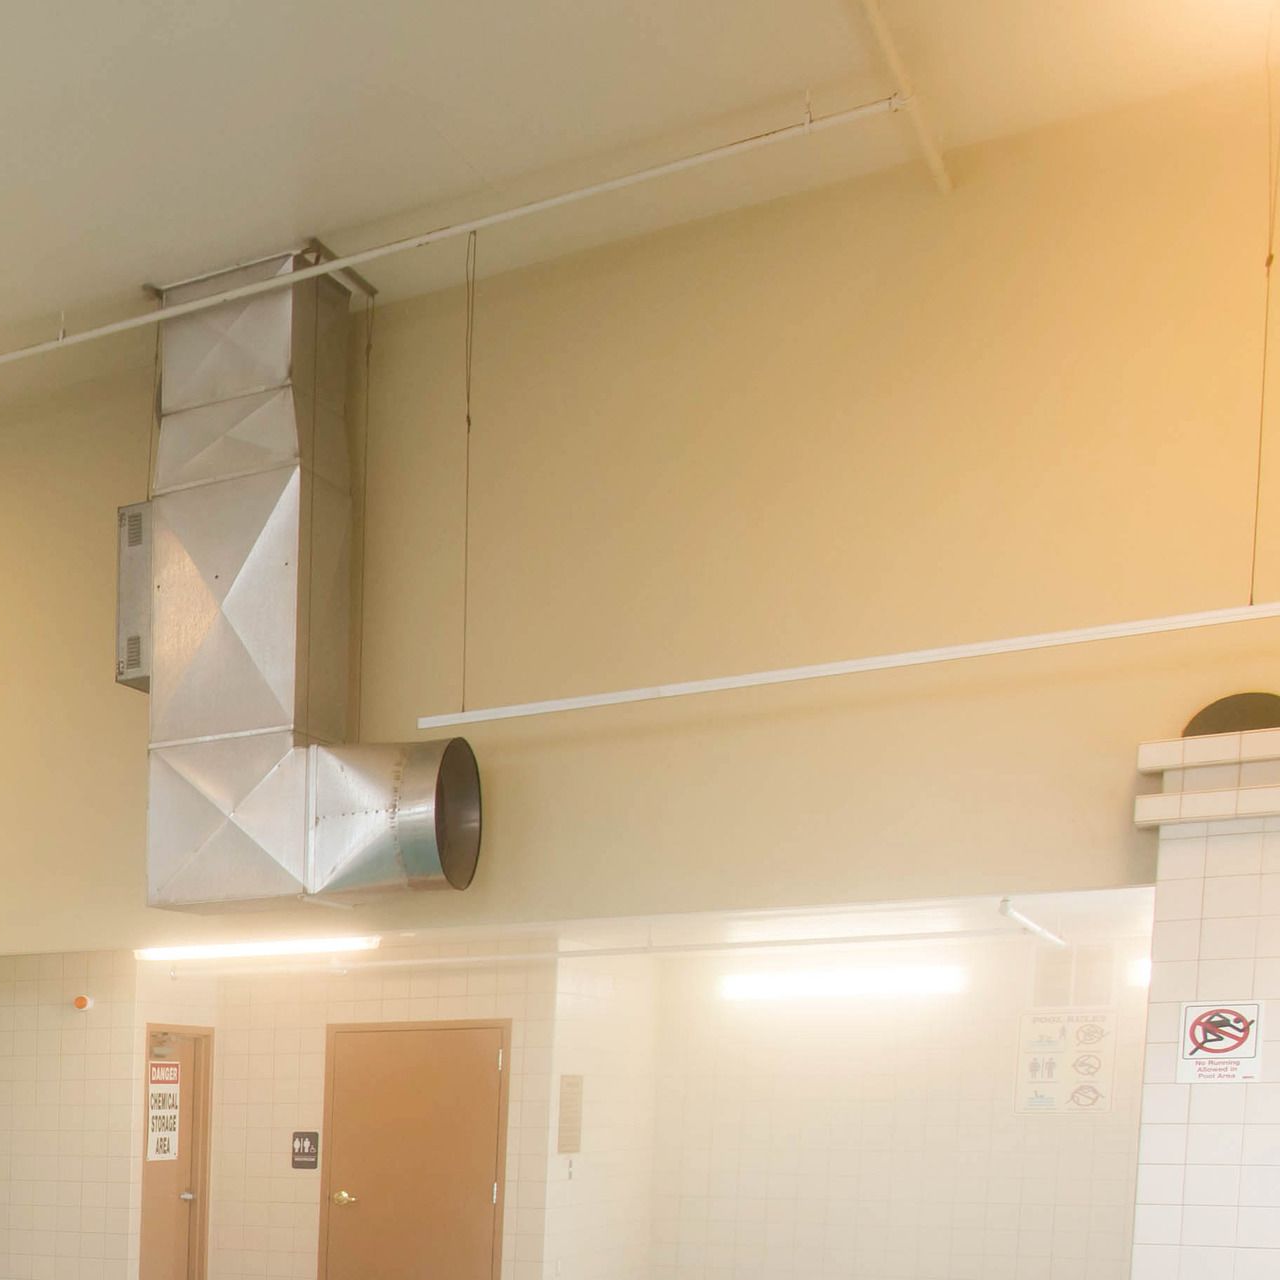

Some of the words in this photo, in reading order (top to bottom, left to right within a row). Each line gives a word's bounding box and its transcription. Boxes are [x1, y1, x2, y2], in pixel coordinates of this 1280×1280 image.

[151, 1066, 178, 1081] DANGER
[151, 1092, 178, 1110] CHEMICAL
[151, 1114, 177, 1132] STORAGE
[155, 1136, 171, 1154] AREA
